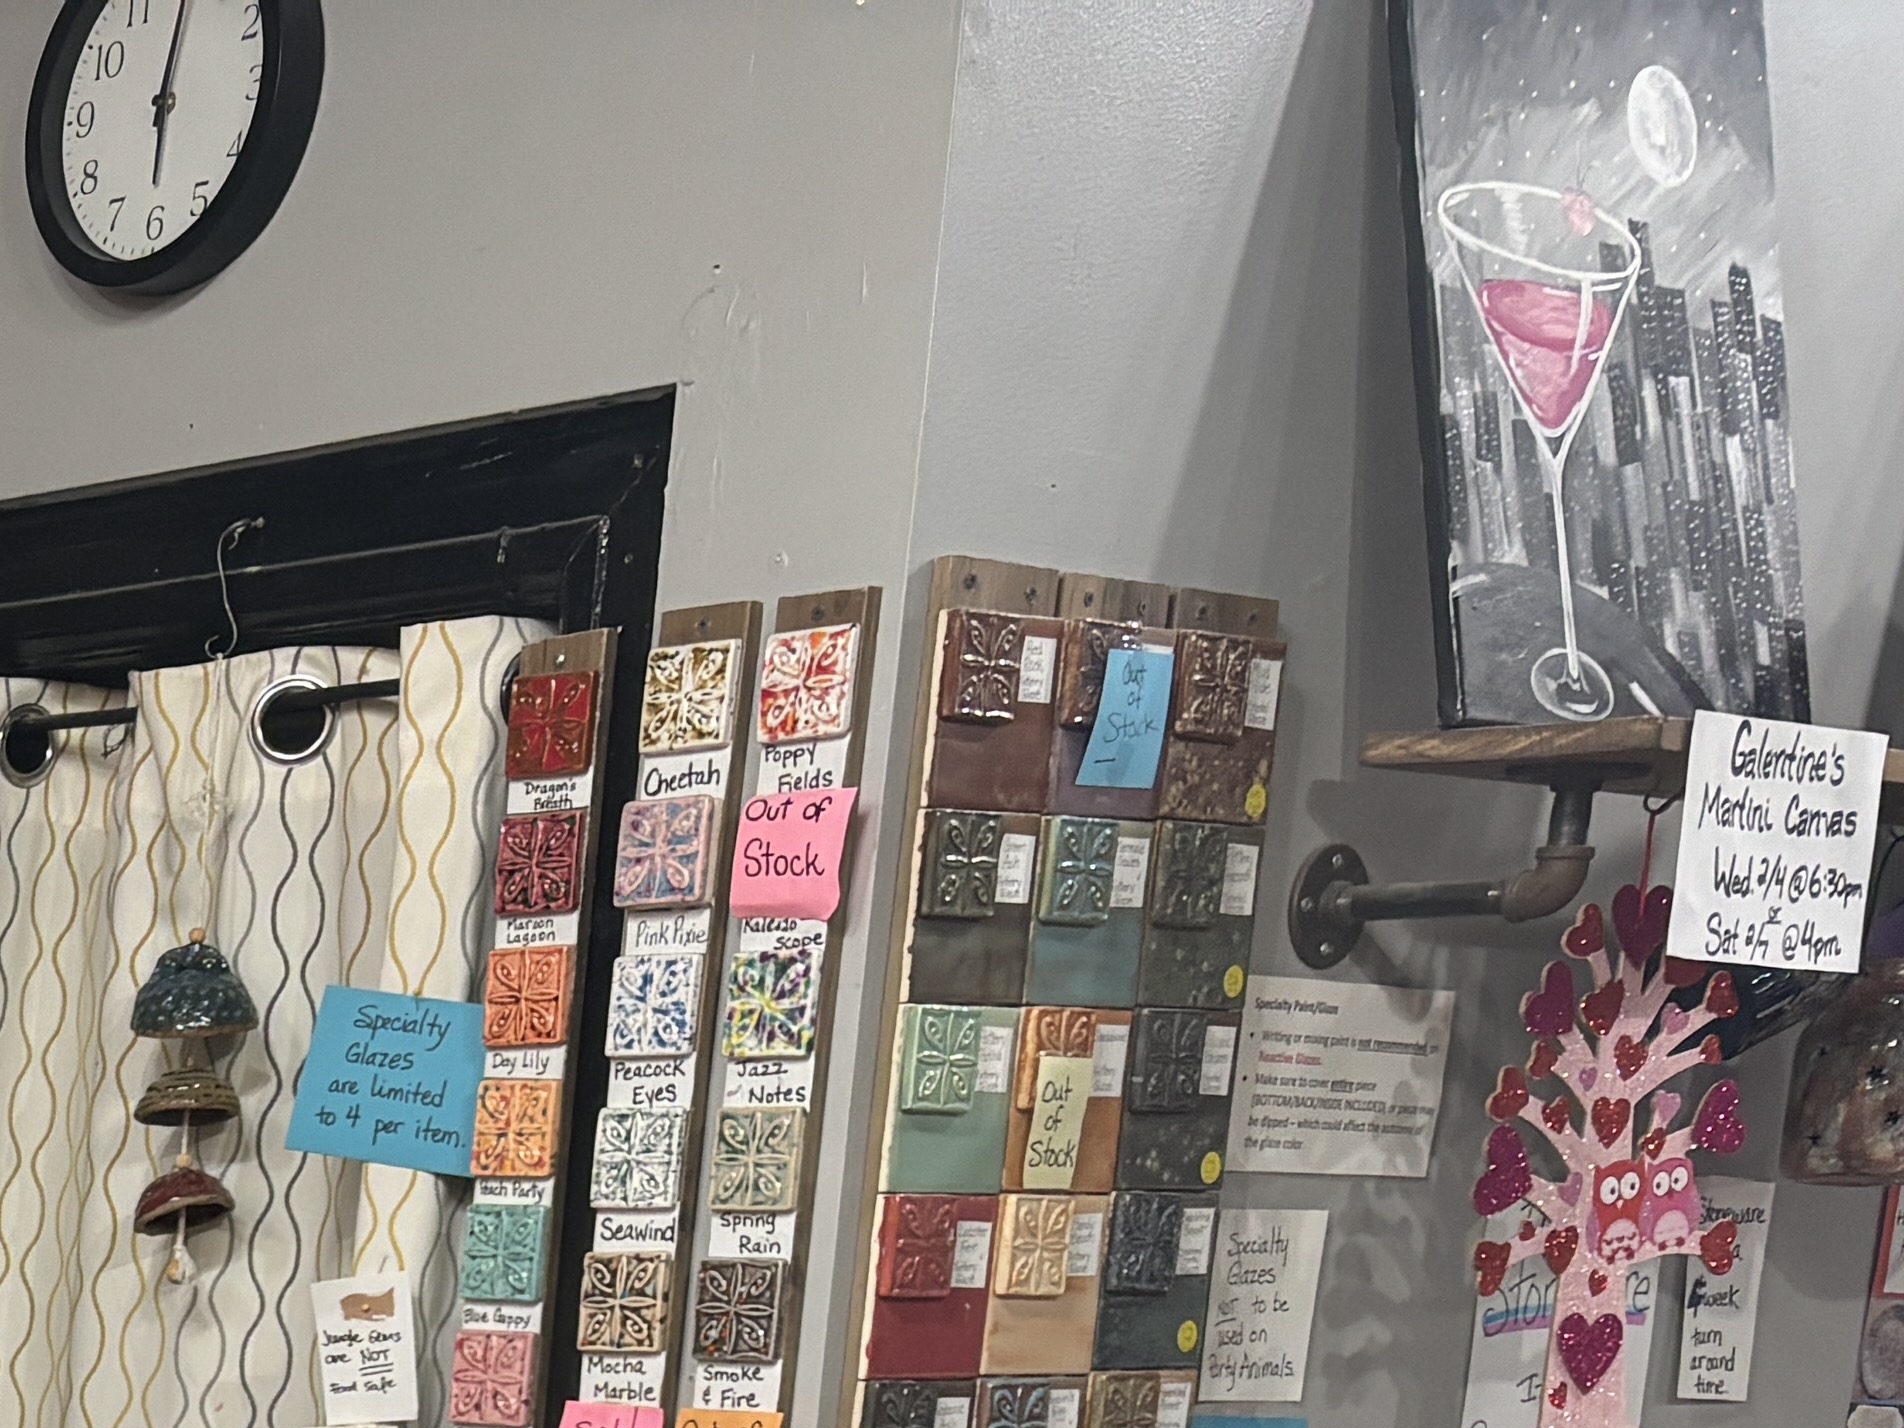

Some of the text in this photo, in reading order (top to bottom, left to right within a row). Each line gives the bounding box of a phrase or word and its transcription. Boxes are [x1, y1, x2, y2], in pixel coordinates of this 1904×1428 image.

[94, 40, 125, 81] 10
[76, 101, 95, 138] 9
[80, 159, 99, 195] 8
[108, 195, 126, 232] 7
[146, 205, 165, 240] 6
[765, 743, 817, 766] Poppy
[1730, 719, 1845, 786] Galentine's
[524, 780, 577, 799] Dragon's
[643, 759, 721, 797] Cheetah
[778, 768, 833, 794] Fields
[745, 798, 833, 823] Out of
[1698, 782, 1858, 837] Martini Canvas
[744, 838, 825, 878] Stock
[635, 921, 709, 948] Pink Pixie
[774, 931, 824, 950] scope
[1705, 912, 1740, 956] Sat
[353, 1004, 451, 1051] Specialty
[345, 1042, 414, 1071] Glazes
[492, 1052, 550, 1076] Day Lily
[614, 1059, 686, 1081] Peacock
[736, 1061, 788, 1077] Jazz
[328, 1074, 448, 1107] are limited
[632, 1085, 677, 1105] Eyes
[748, 1085, 806, 1104] Notes
[1042, 1079, 1074, 1103] Out
[314, 1104, 466, 1148] to 4 per item.
[1044, 1104, 1063, 1132] of
[1028, 1140, 1078, 1169] Stock
[600, 1217, 676, 1244] Seawind
[1228, 1225, 1289, 1261] Specialty
[739, 1235, 781, 1254] Rain
[1272, 1296, 1290, 1313] be
[1249, 1328, 1267, 1344] on
[587, 1356, 647, 1375] Mocha
[703, 1365, 764, 1387] Smoke
[593, 1376, 657, 1401] Marble
[721, 1390, 761, 1408] Fire
